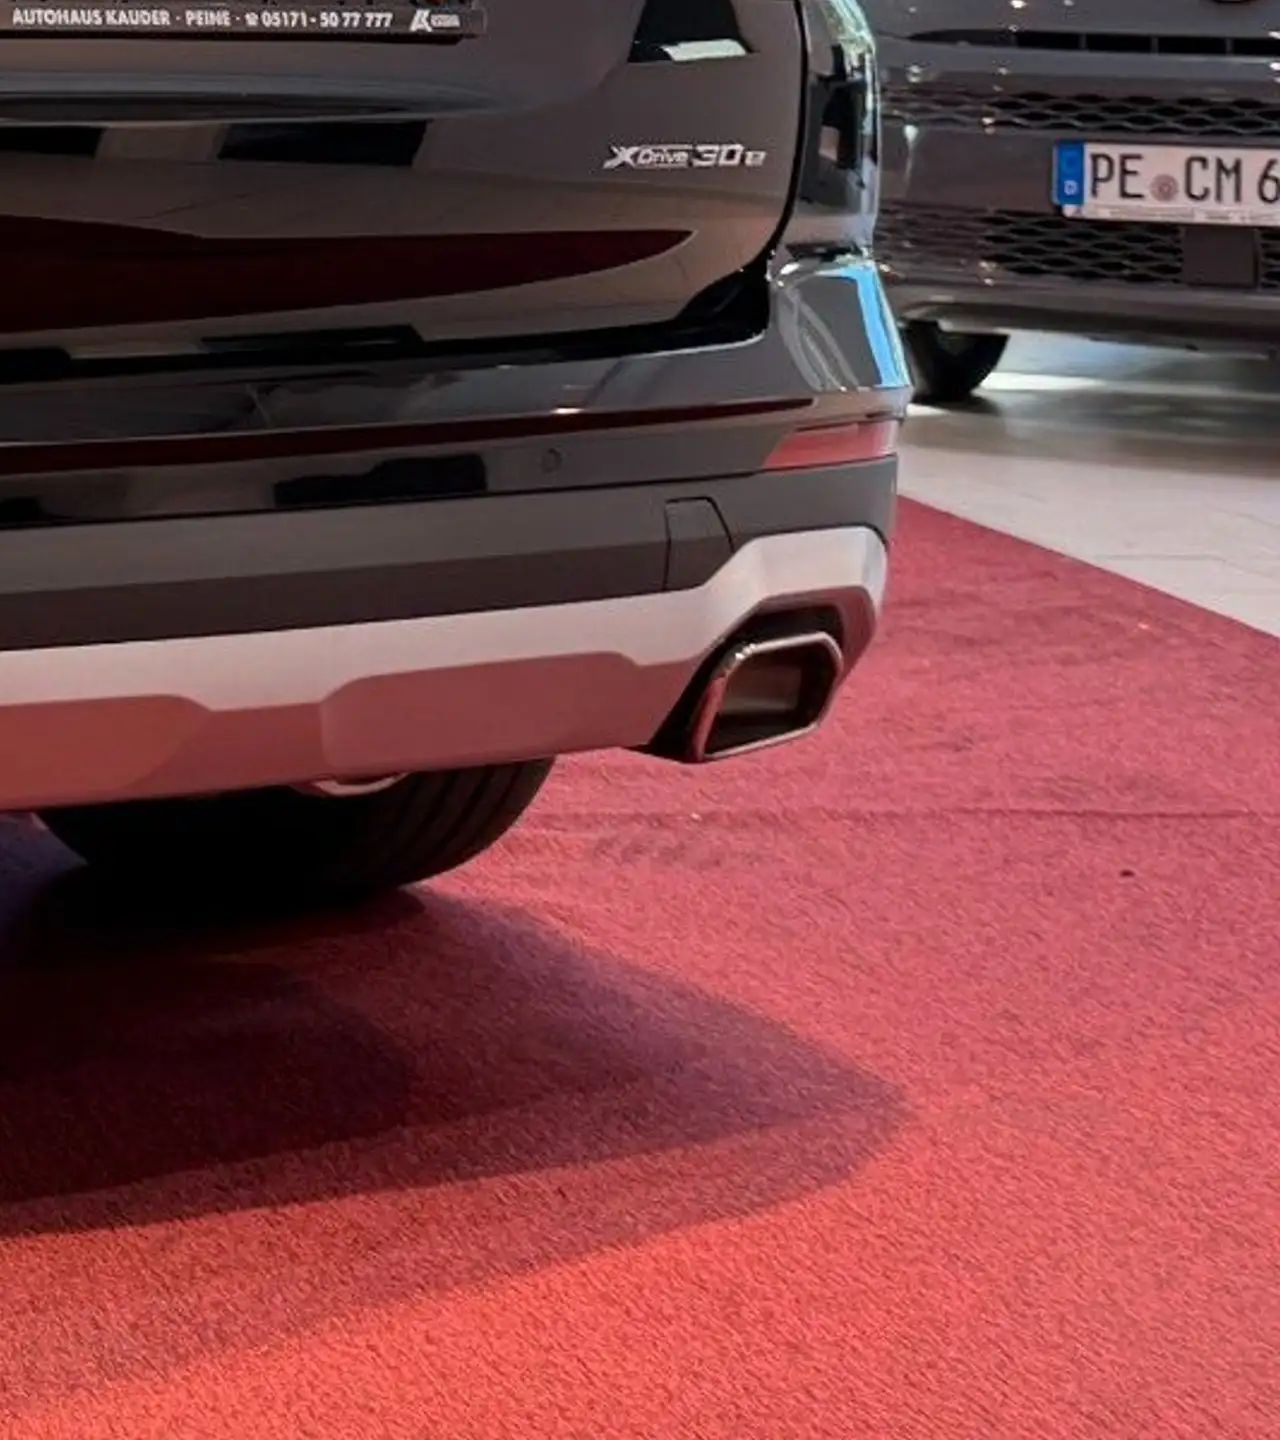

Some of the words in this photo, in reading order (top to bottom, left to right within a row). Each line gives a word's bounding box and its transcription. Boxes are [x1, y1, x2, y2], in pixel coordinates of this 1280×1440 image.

[12, 8, 102, 26] AUTOHAUS
[105, 9, 171, 26] KAUDER
[185, 9, 231, 27] PEINE
[261, 10, 307, 28] 05171
[341, 10, 359, 28] 77
[364, 10, 393, 28] 777
[1090, 152, 1144, 199] PE
[1184, 156, 1244, 203] CM
